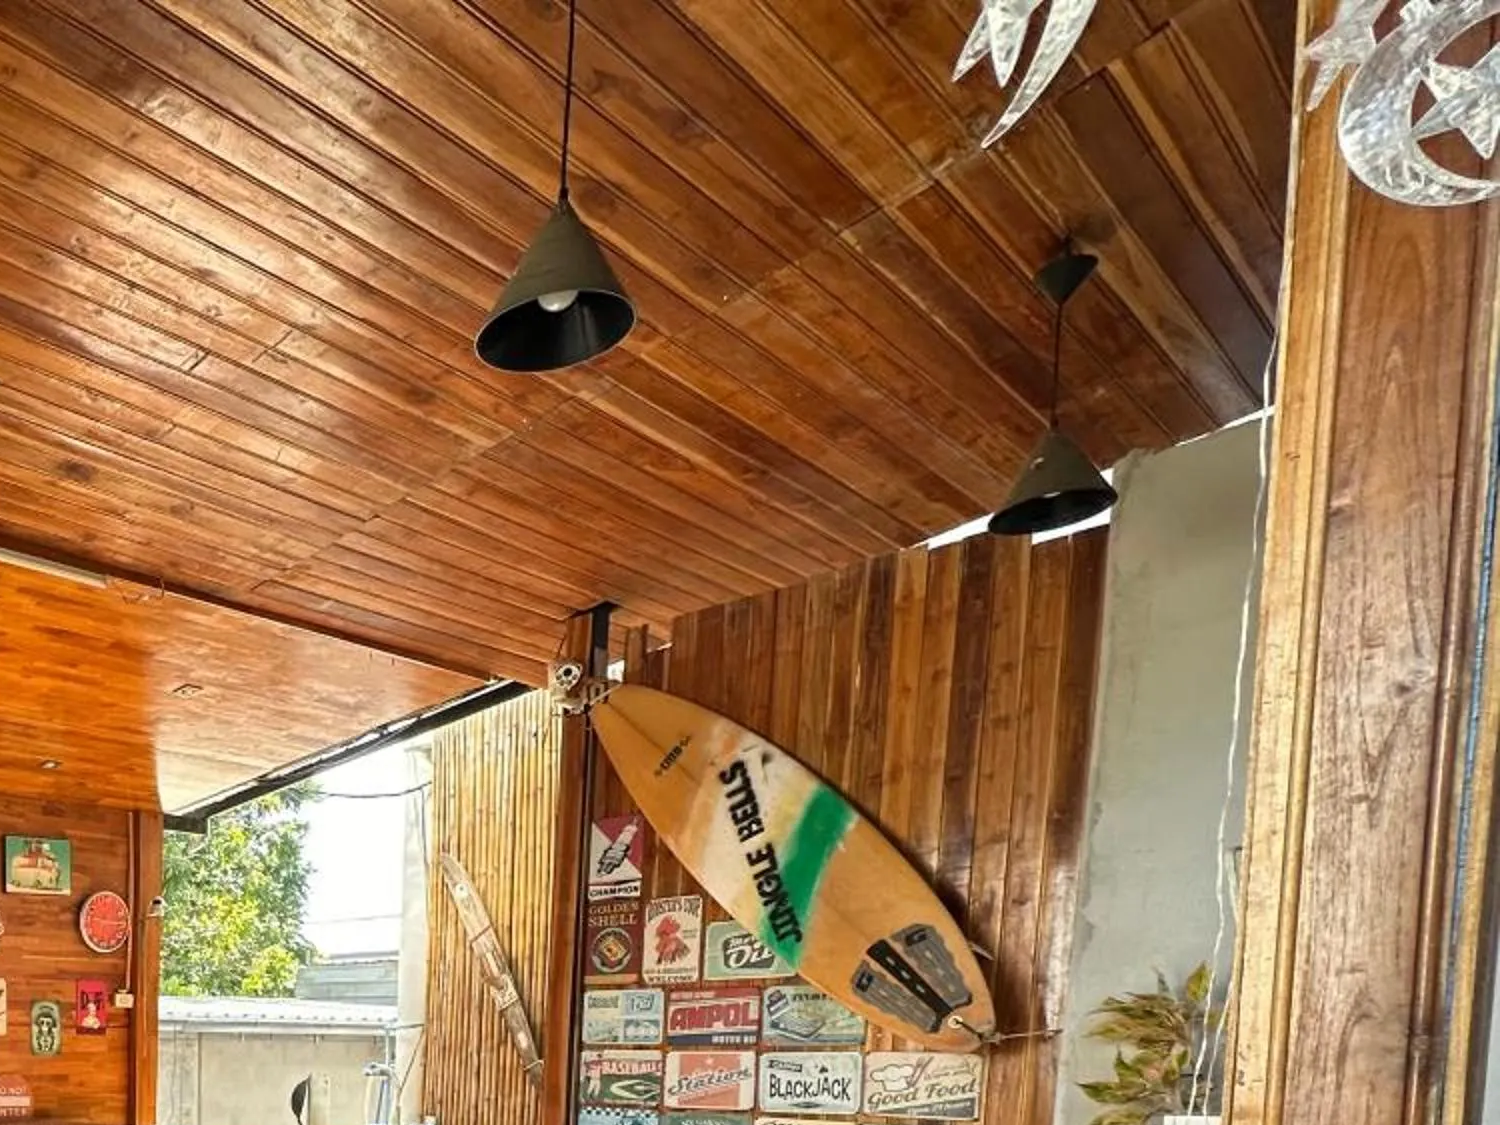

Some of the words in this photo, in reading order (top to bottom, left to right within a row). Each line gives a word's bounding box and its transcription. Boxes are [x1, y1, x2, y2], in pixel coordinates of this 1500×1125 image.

[719, 760, 765, 843] BELLS
[589, 885, 639, 897] CHAMPION
[746, 842, 804, 945] JINGLE
[588, 914, 637, 927] SHELL
[589, 902, 639, 915] GOLDEN
[670, 1002, 758, 1031] AMPOL
[769, 1074, 853, 1101] BLACKJACK
[868, 1087, 918, 1108] Good
[925, 1078, 976, 1098] Food
